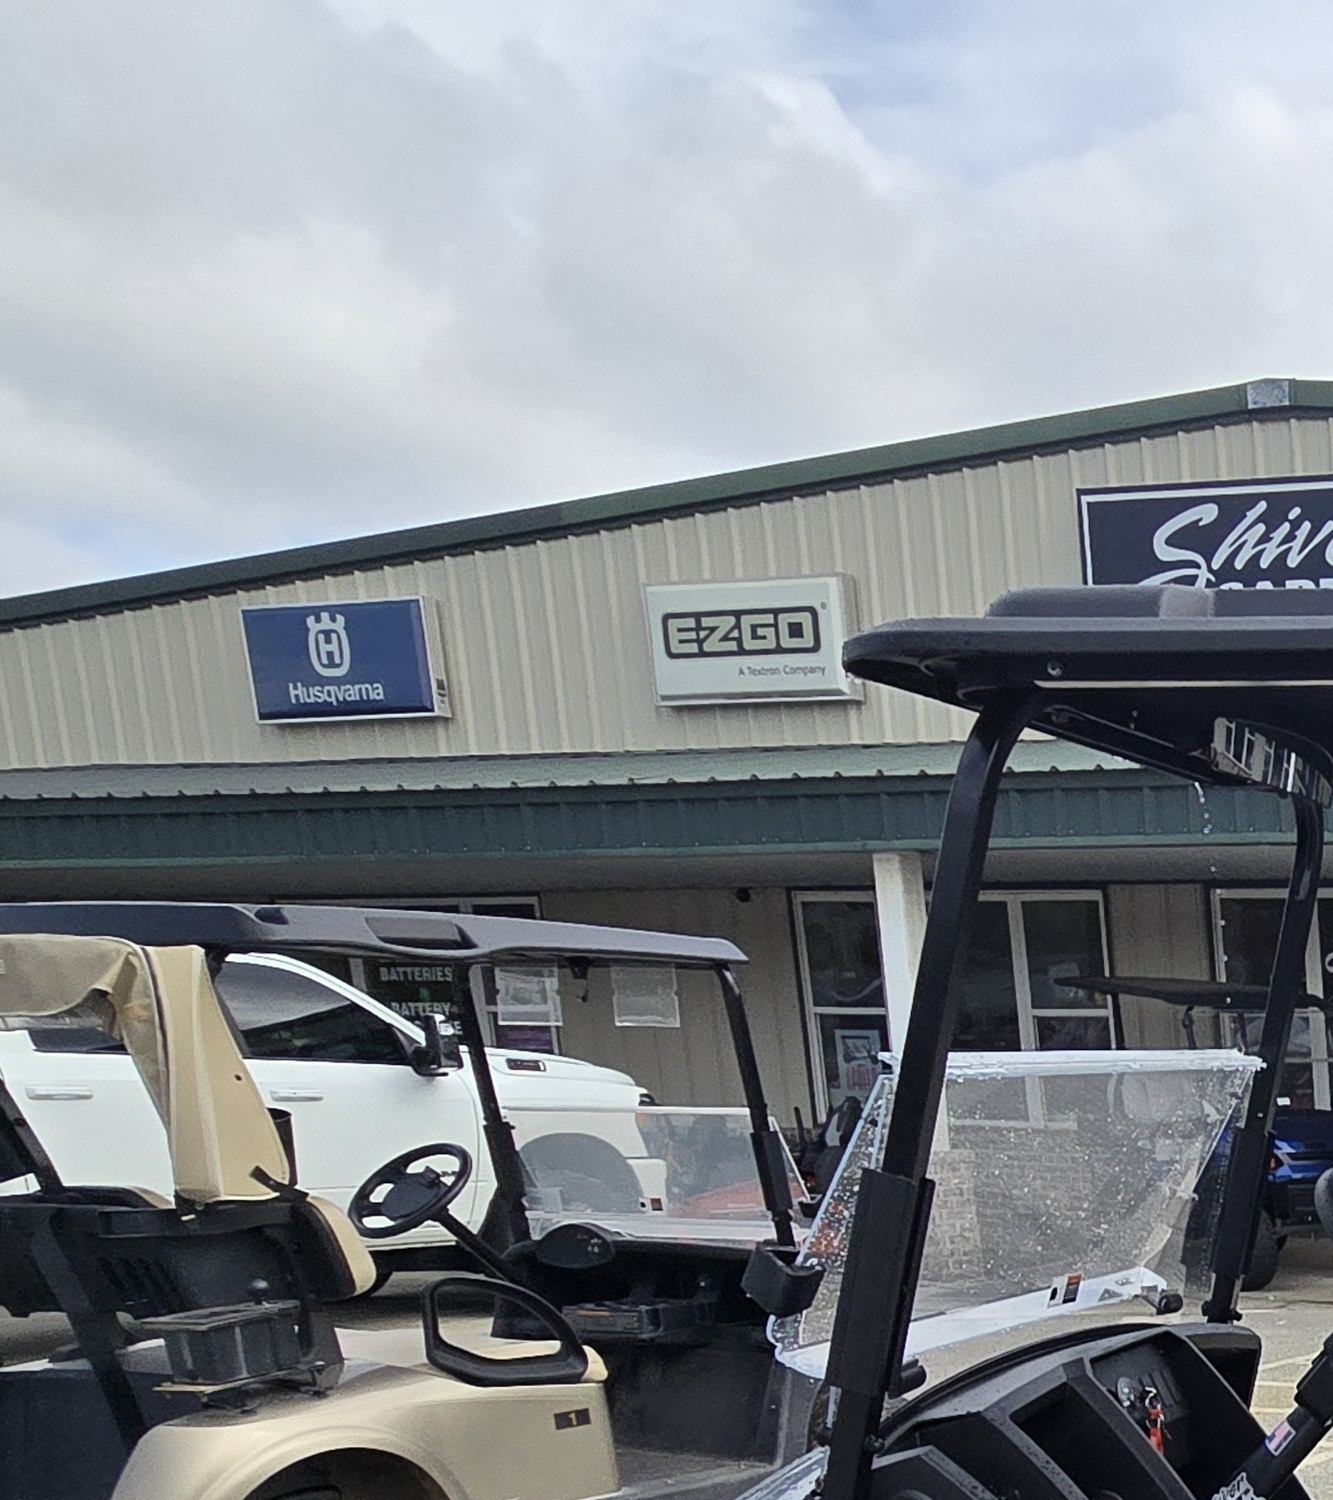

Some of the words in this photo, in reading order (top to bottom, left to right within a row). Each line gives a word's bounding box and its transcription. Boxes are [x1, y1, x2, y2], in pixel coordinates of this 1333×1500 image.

[747, 666, 781, 677] Textron
[783, 664, 826, 677] Company
[288, 682, 385, 706] Husqvarna
[379, 966, 453, 982] BATTERIES
[568, 1412, 577, 1426] 1
